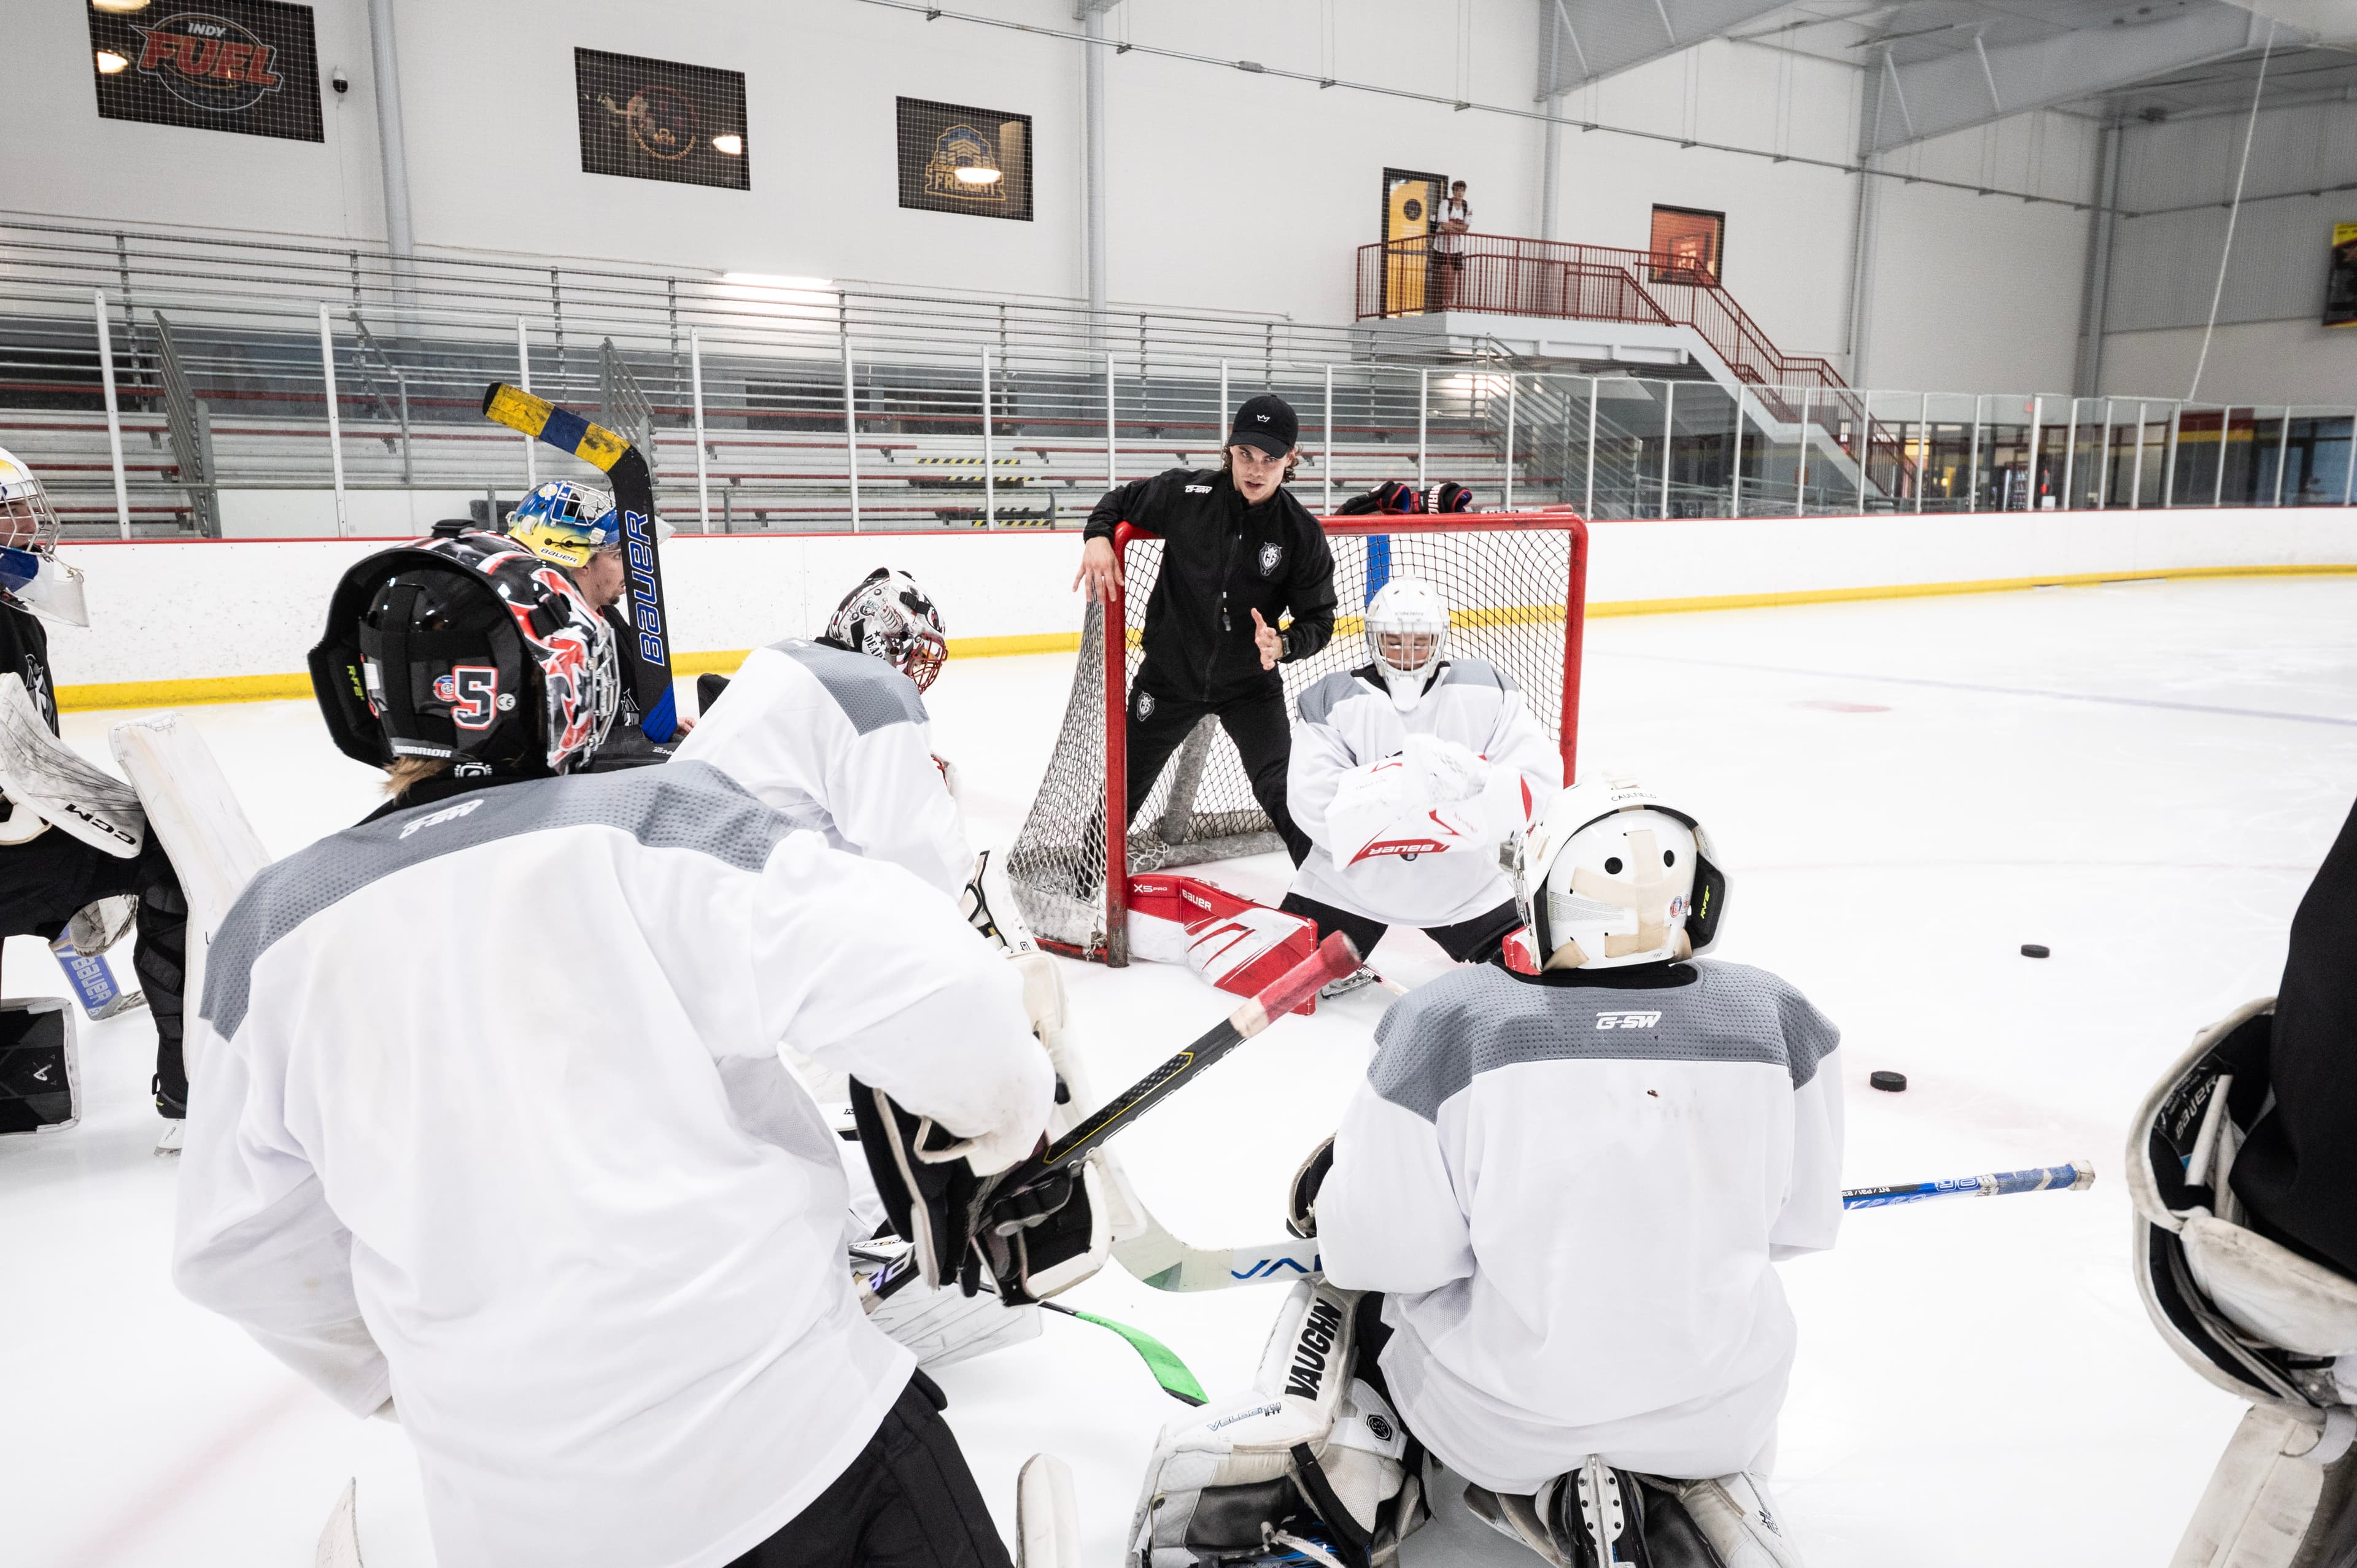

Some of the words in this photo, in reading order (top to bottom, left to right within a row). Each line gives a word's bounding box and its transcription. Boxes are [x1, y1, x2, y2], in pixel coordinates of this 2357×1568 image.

[187, 22, 226, 37] INDY
[139, 29, 277, 86] FUEL
[1185, 485, 1213, 493] G-SW
[540, 548, 578, 563] BAUER
[625, 510, 665, 666] BAUER
[451, 665, 498, 730] 5
[394, 745, 452, 758] WARRIOR
[1611, 792, 1657, 801] CAULFIELD
[64, 803, 136, 845] CCM
[1369, 844, 1435, 855] BAUER
[1182, 889, 1212, 911] BAUER
[71, 957, 112, 1005] BAUER
[1357, 968, 1375, 979] UER
[1596, 1011, 1662, 1030] G-SW
[2175, 1075, 2217, 1140] BAUER
[1285, 1297, 1342, 1402] VAUGHN
